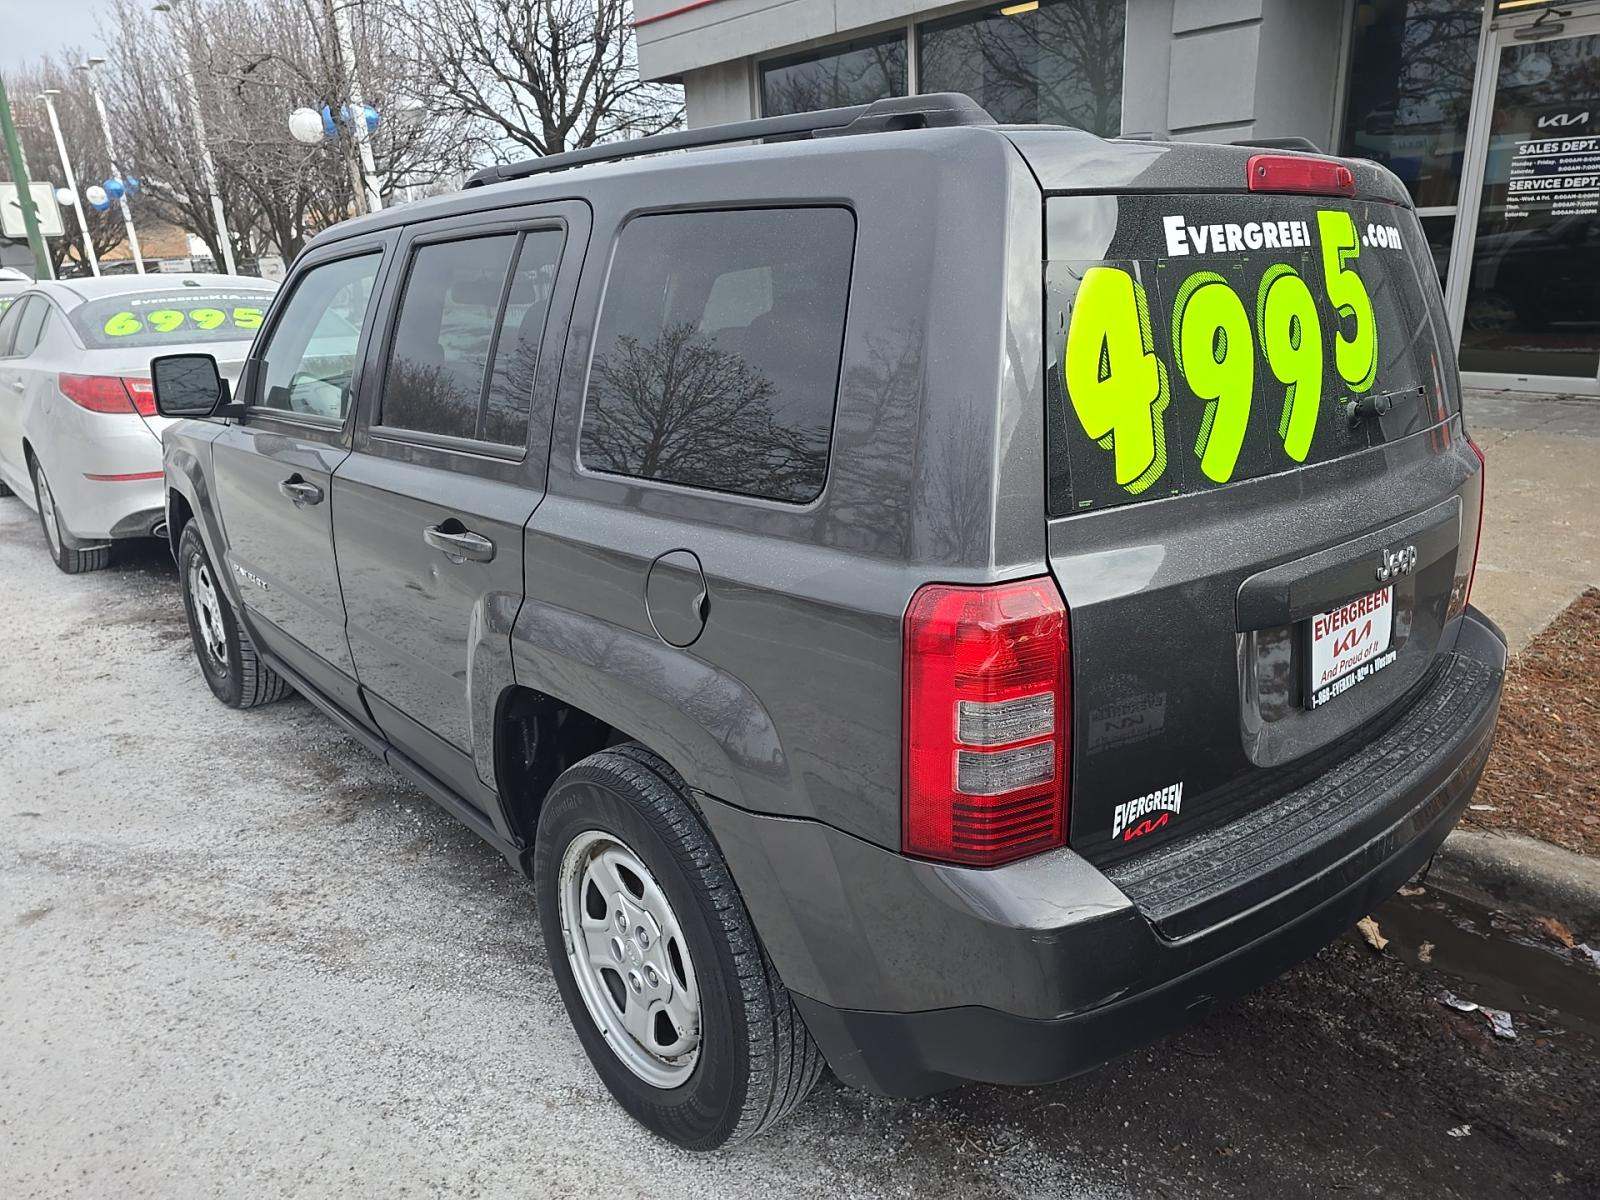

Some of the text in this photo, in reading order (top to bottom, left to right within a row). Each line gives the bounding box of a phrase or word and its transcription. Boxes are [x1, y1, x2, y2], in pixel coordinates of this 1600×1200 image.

[1538, 112, 1589, 128] KIA
[1519, 140, 1599, 155] SALES DEPT.
[1508, 177, 1600, 191] SERVICE DEPT.
[1362, 221, 1403, 250] .com
[104, 307, 263, 336] 6995
[1065, 210, 1378, 494] 4995
[1376, 545, 1418, 581] Jeep
[1314, 587, 1389, 642] EVERGREEN
[1333, 619, 1372, 657] KIA
[1320, 641, 1379, 684] And Proud of It
[1112, 781, 1184, 839] EVERGREEN
[1124, 813, 1169, 841] KIA
